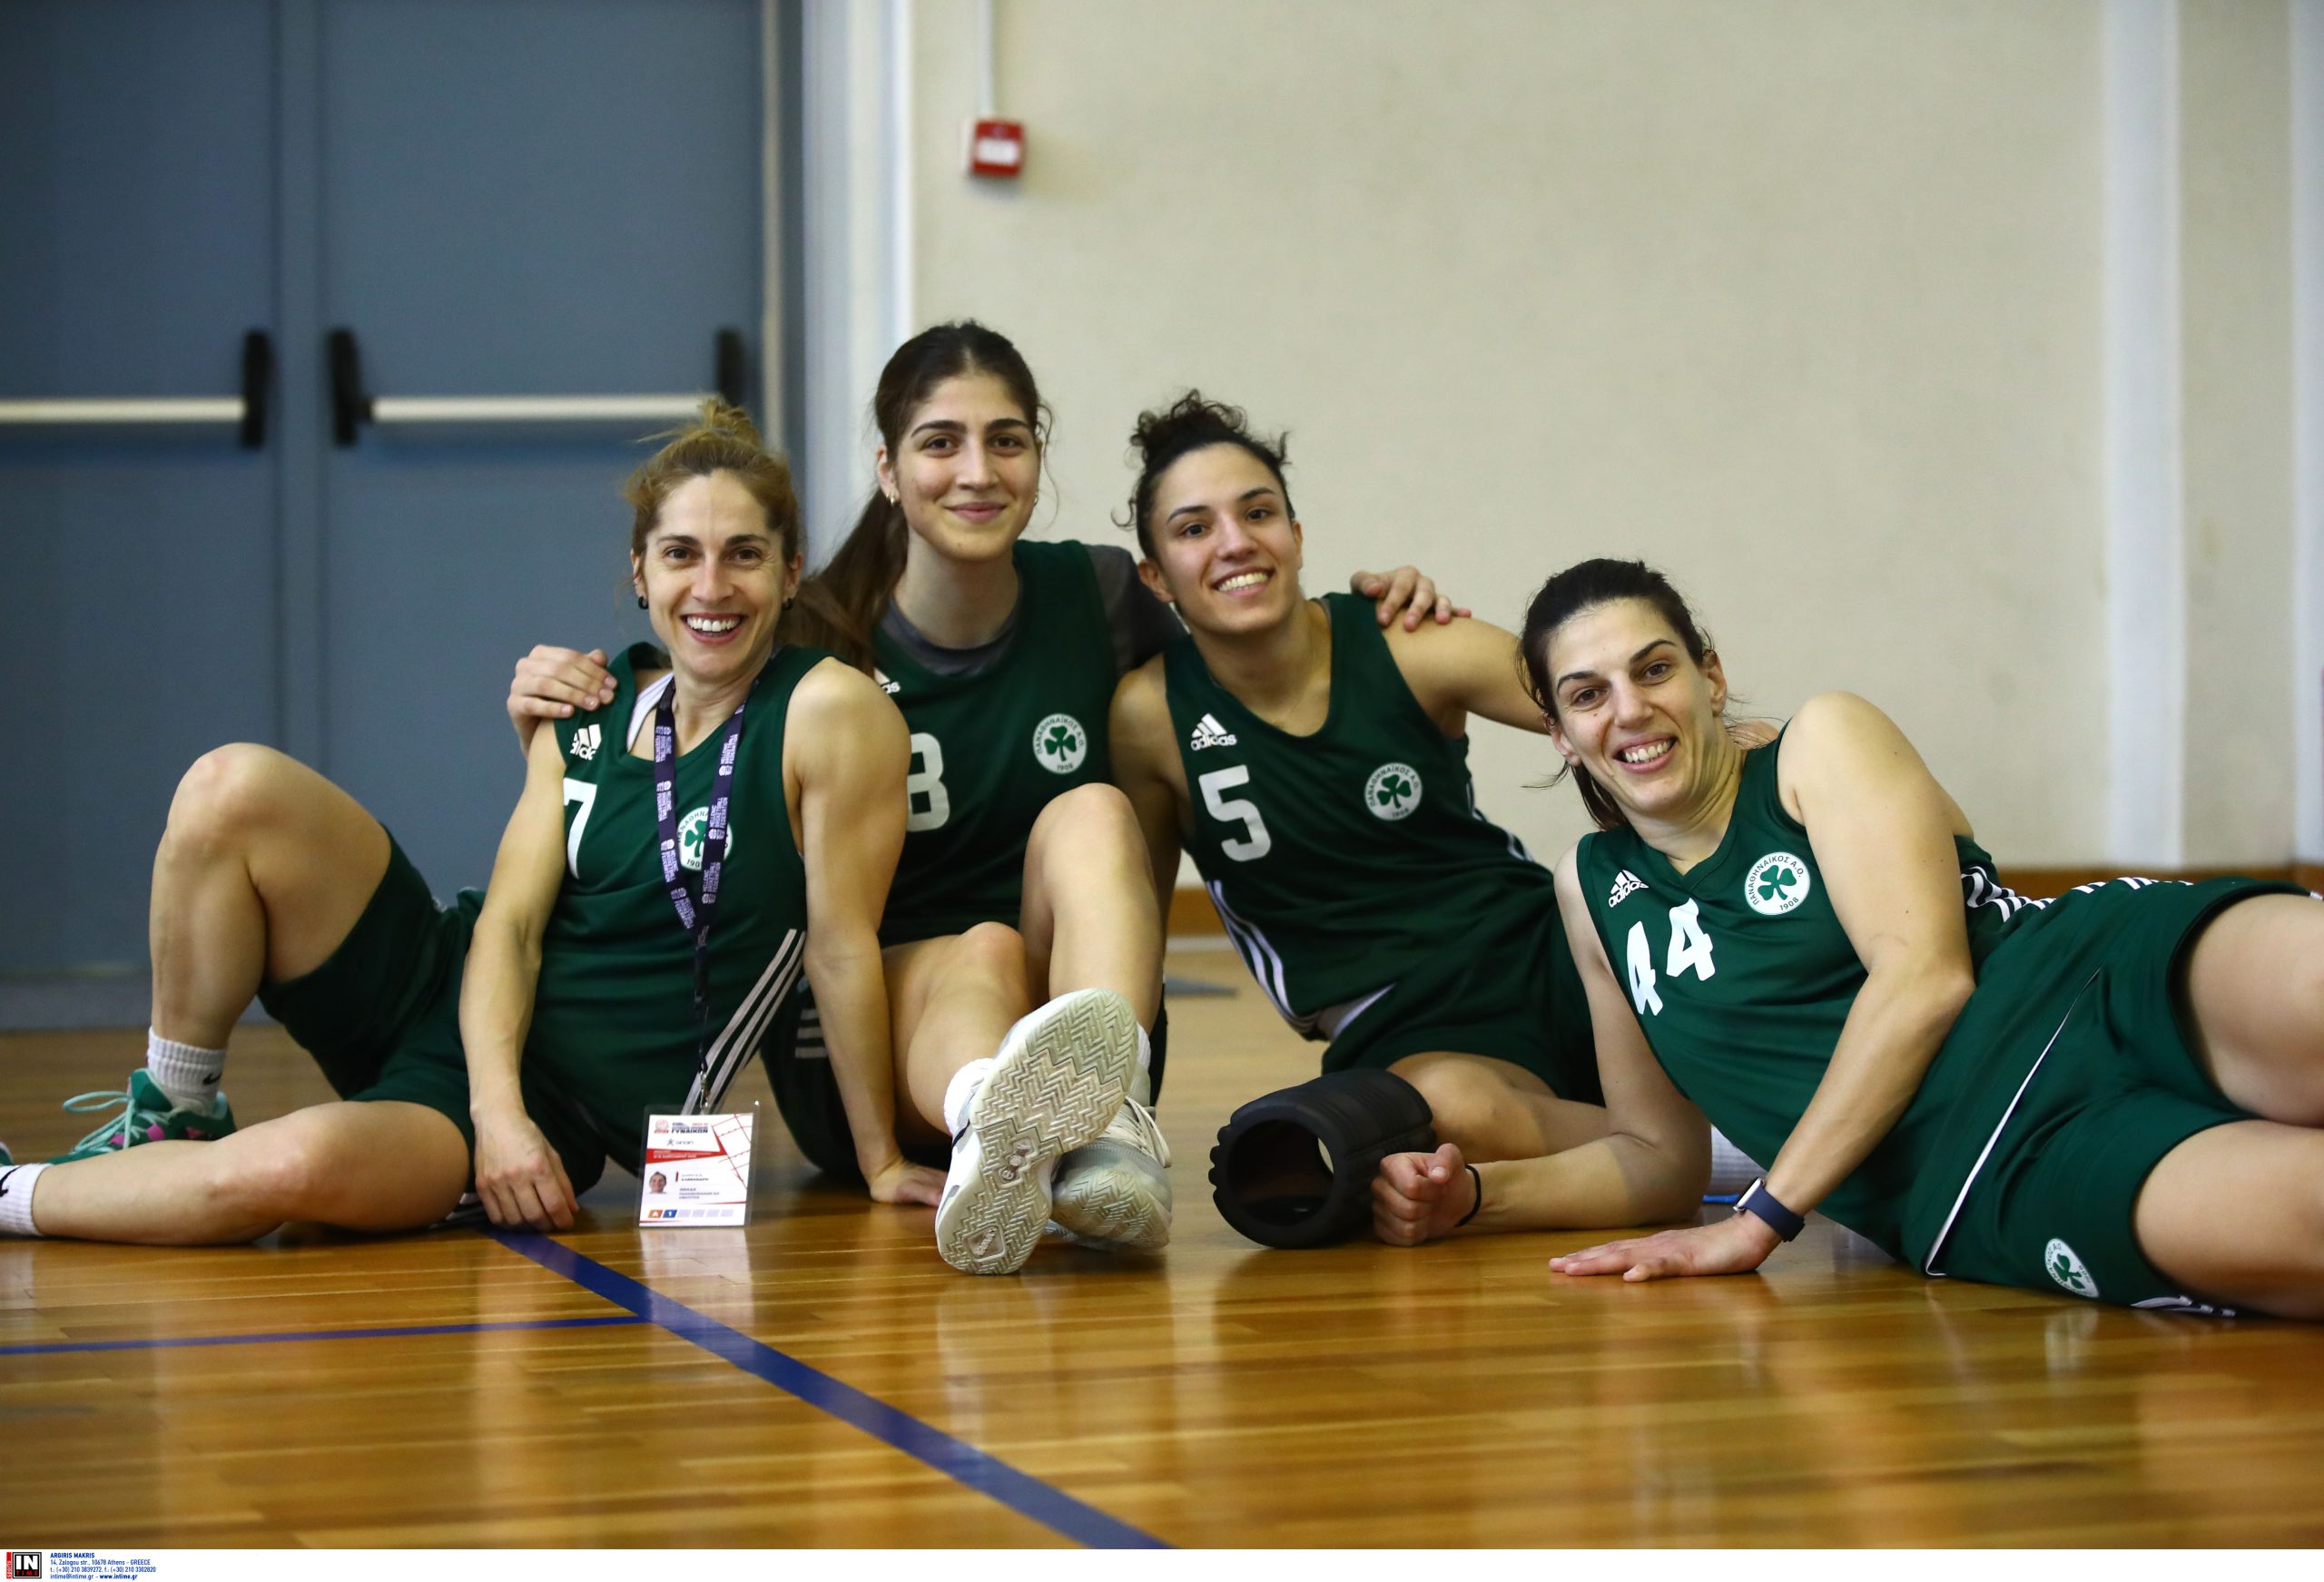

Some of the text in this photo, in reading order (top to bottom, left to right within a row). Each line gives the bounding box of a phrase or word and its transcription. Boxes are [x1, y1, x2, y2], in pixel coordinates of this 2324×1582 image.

[1190, 732, 1237, 752] adidas
[563, 777, 598, 879] 7
[1198, 764, 1271, 862] 5
[1779, 897, 1799, 911] 1908
